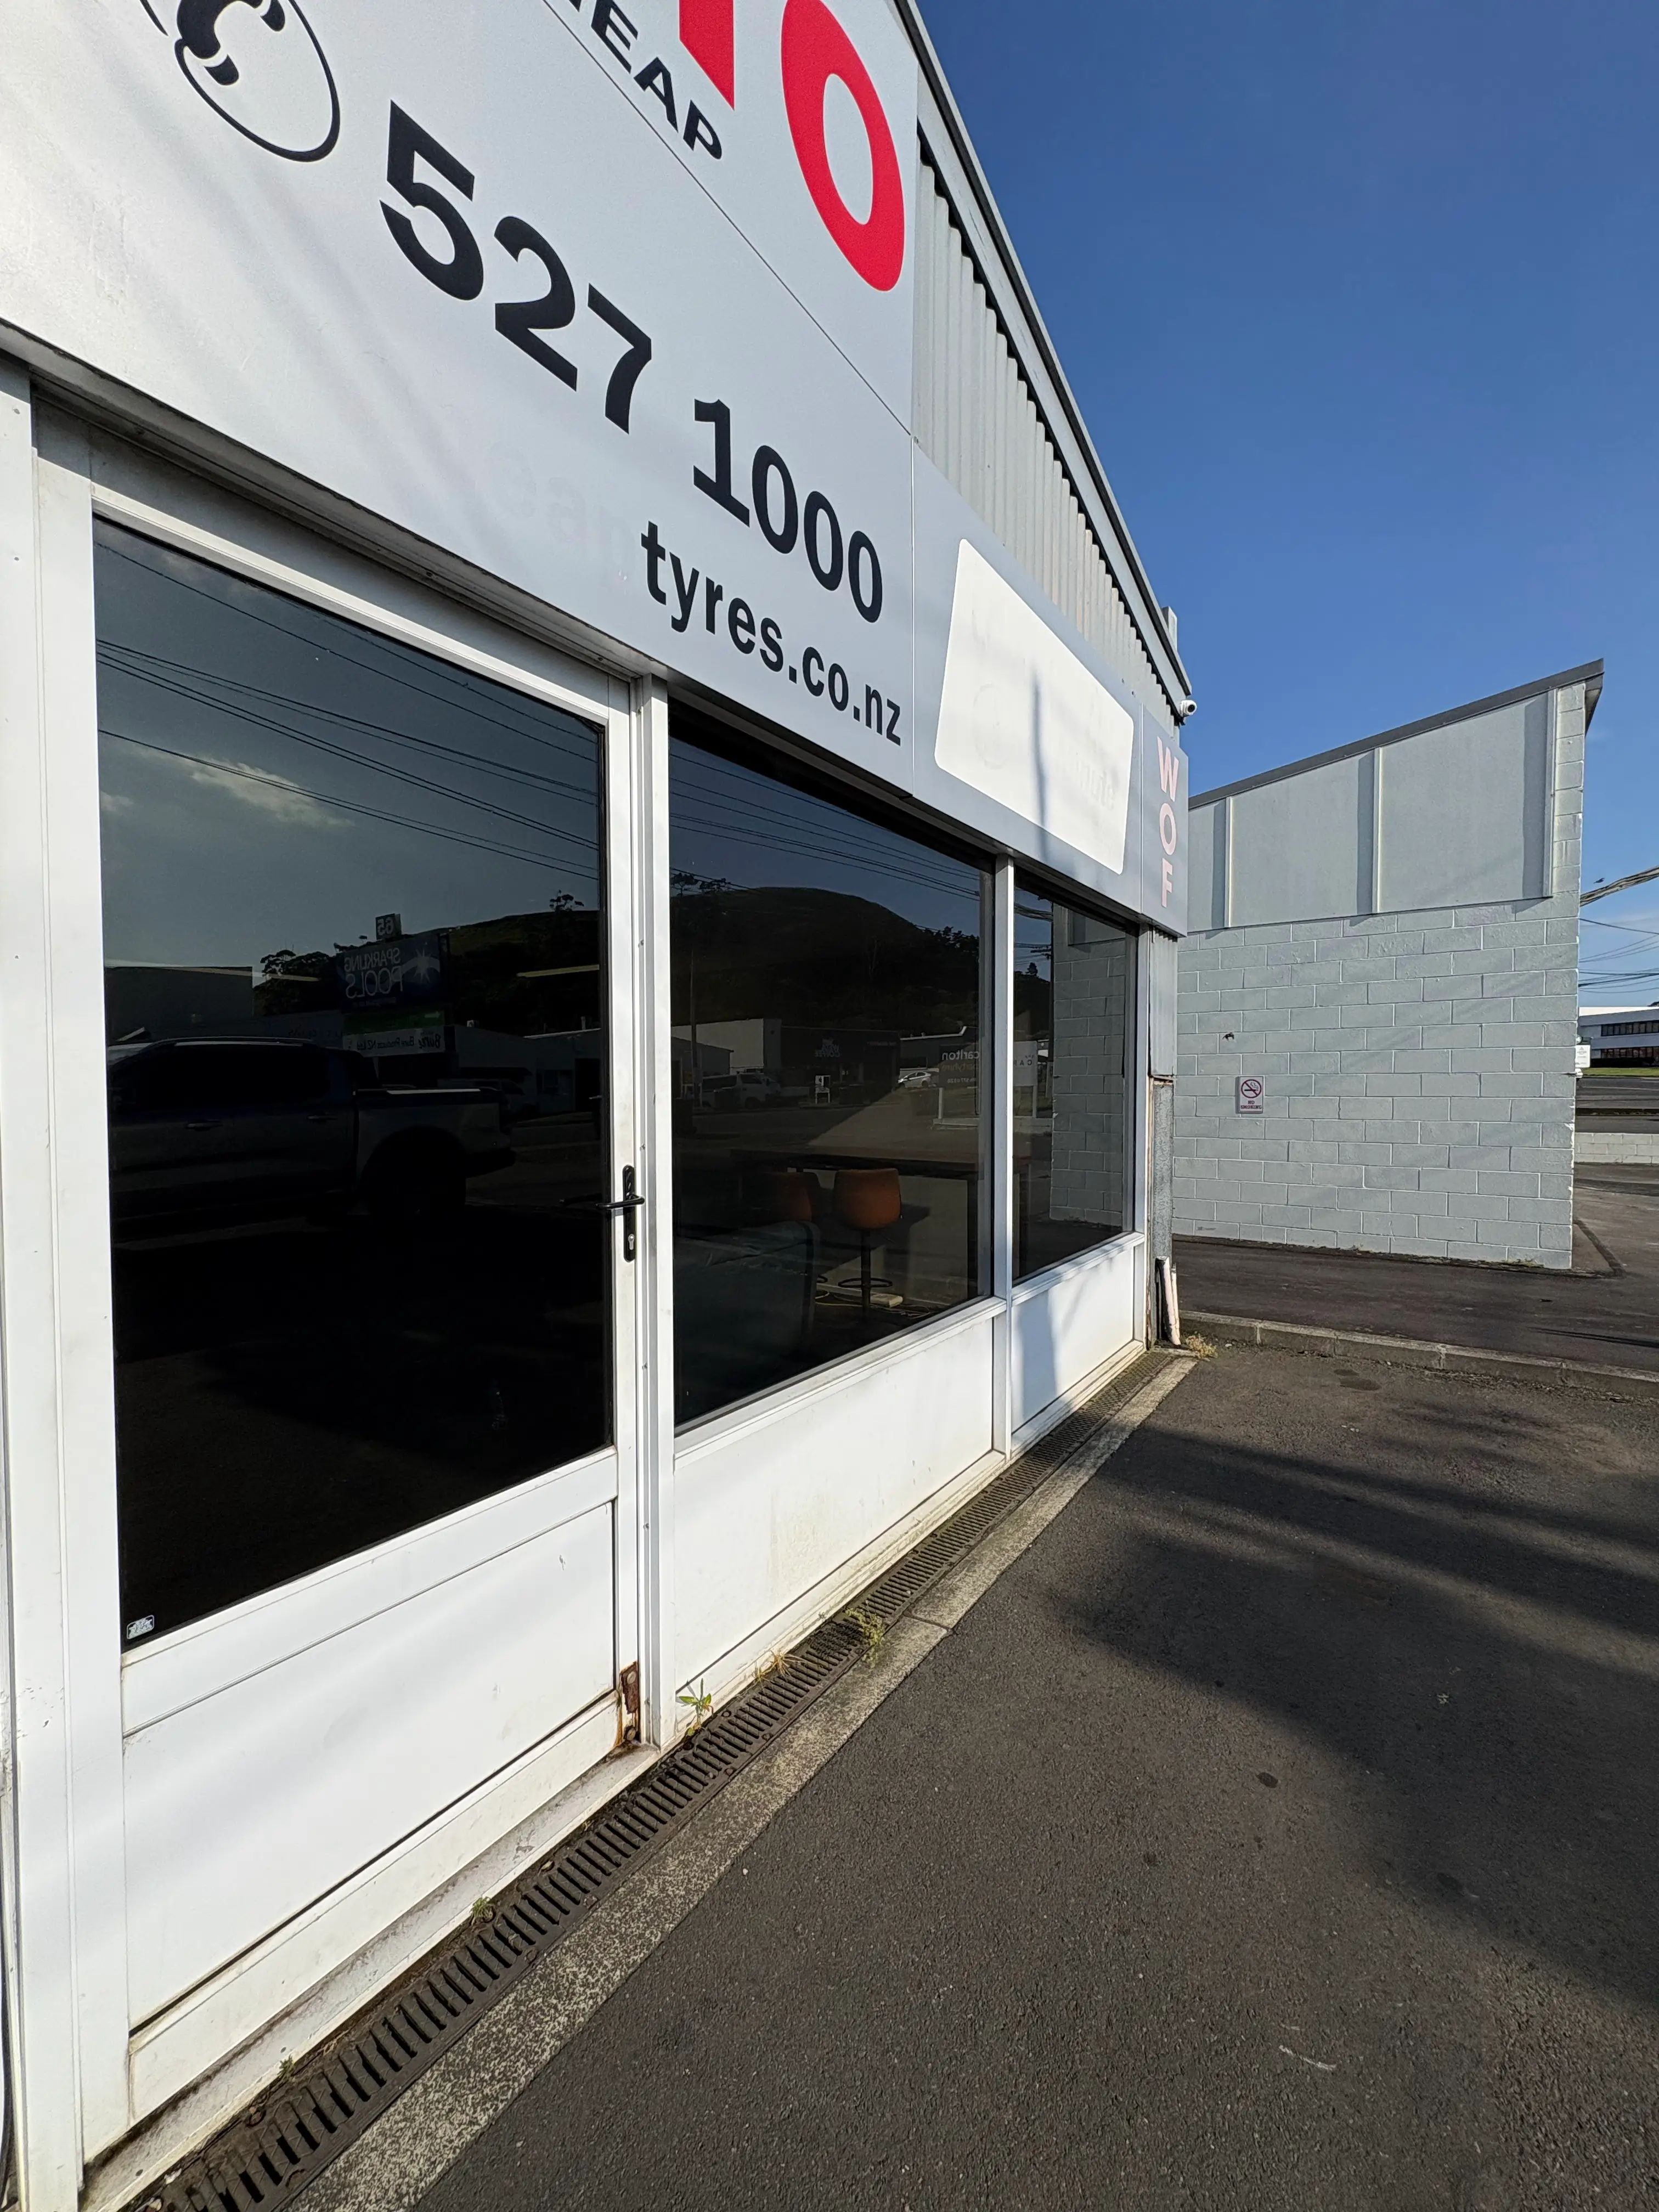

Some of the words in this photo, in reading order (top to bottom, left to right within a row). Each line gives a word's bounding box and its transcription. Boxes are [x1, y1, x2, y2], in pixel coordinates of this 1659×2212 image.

[567, 0, 722, 159] EAP
[380, 99, 652, 435] 527
[693, 399, 883, 623] 1000
[641, 521, 901, 746] tyres.co.nz
[1157, 736, 1179, 908] WOF
